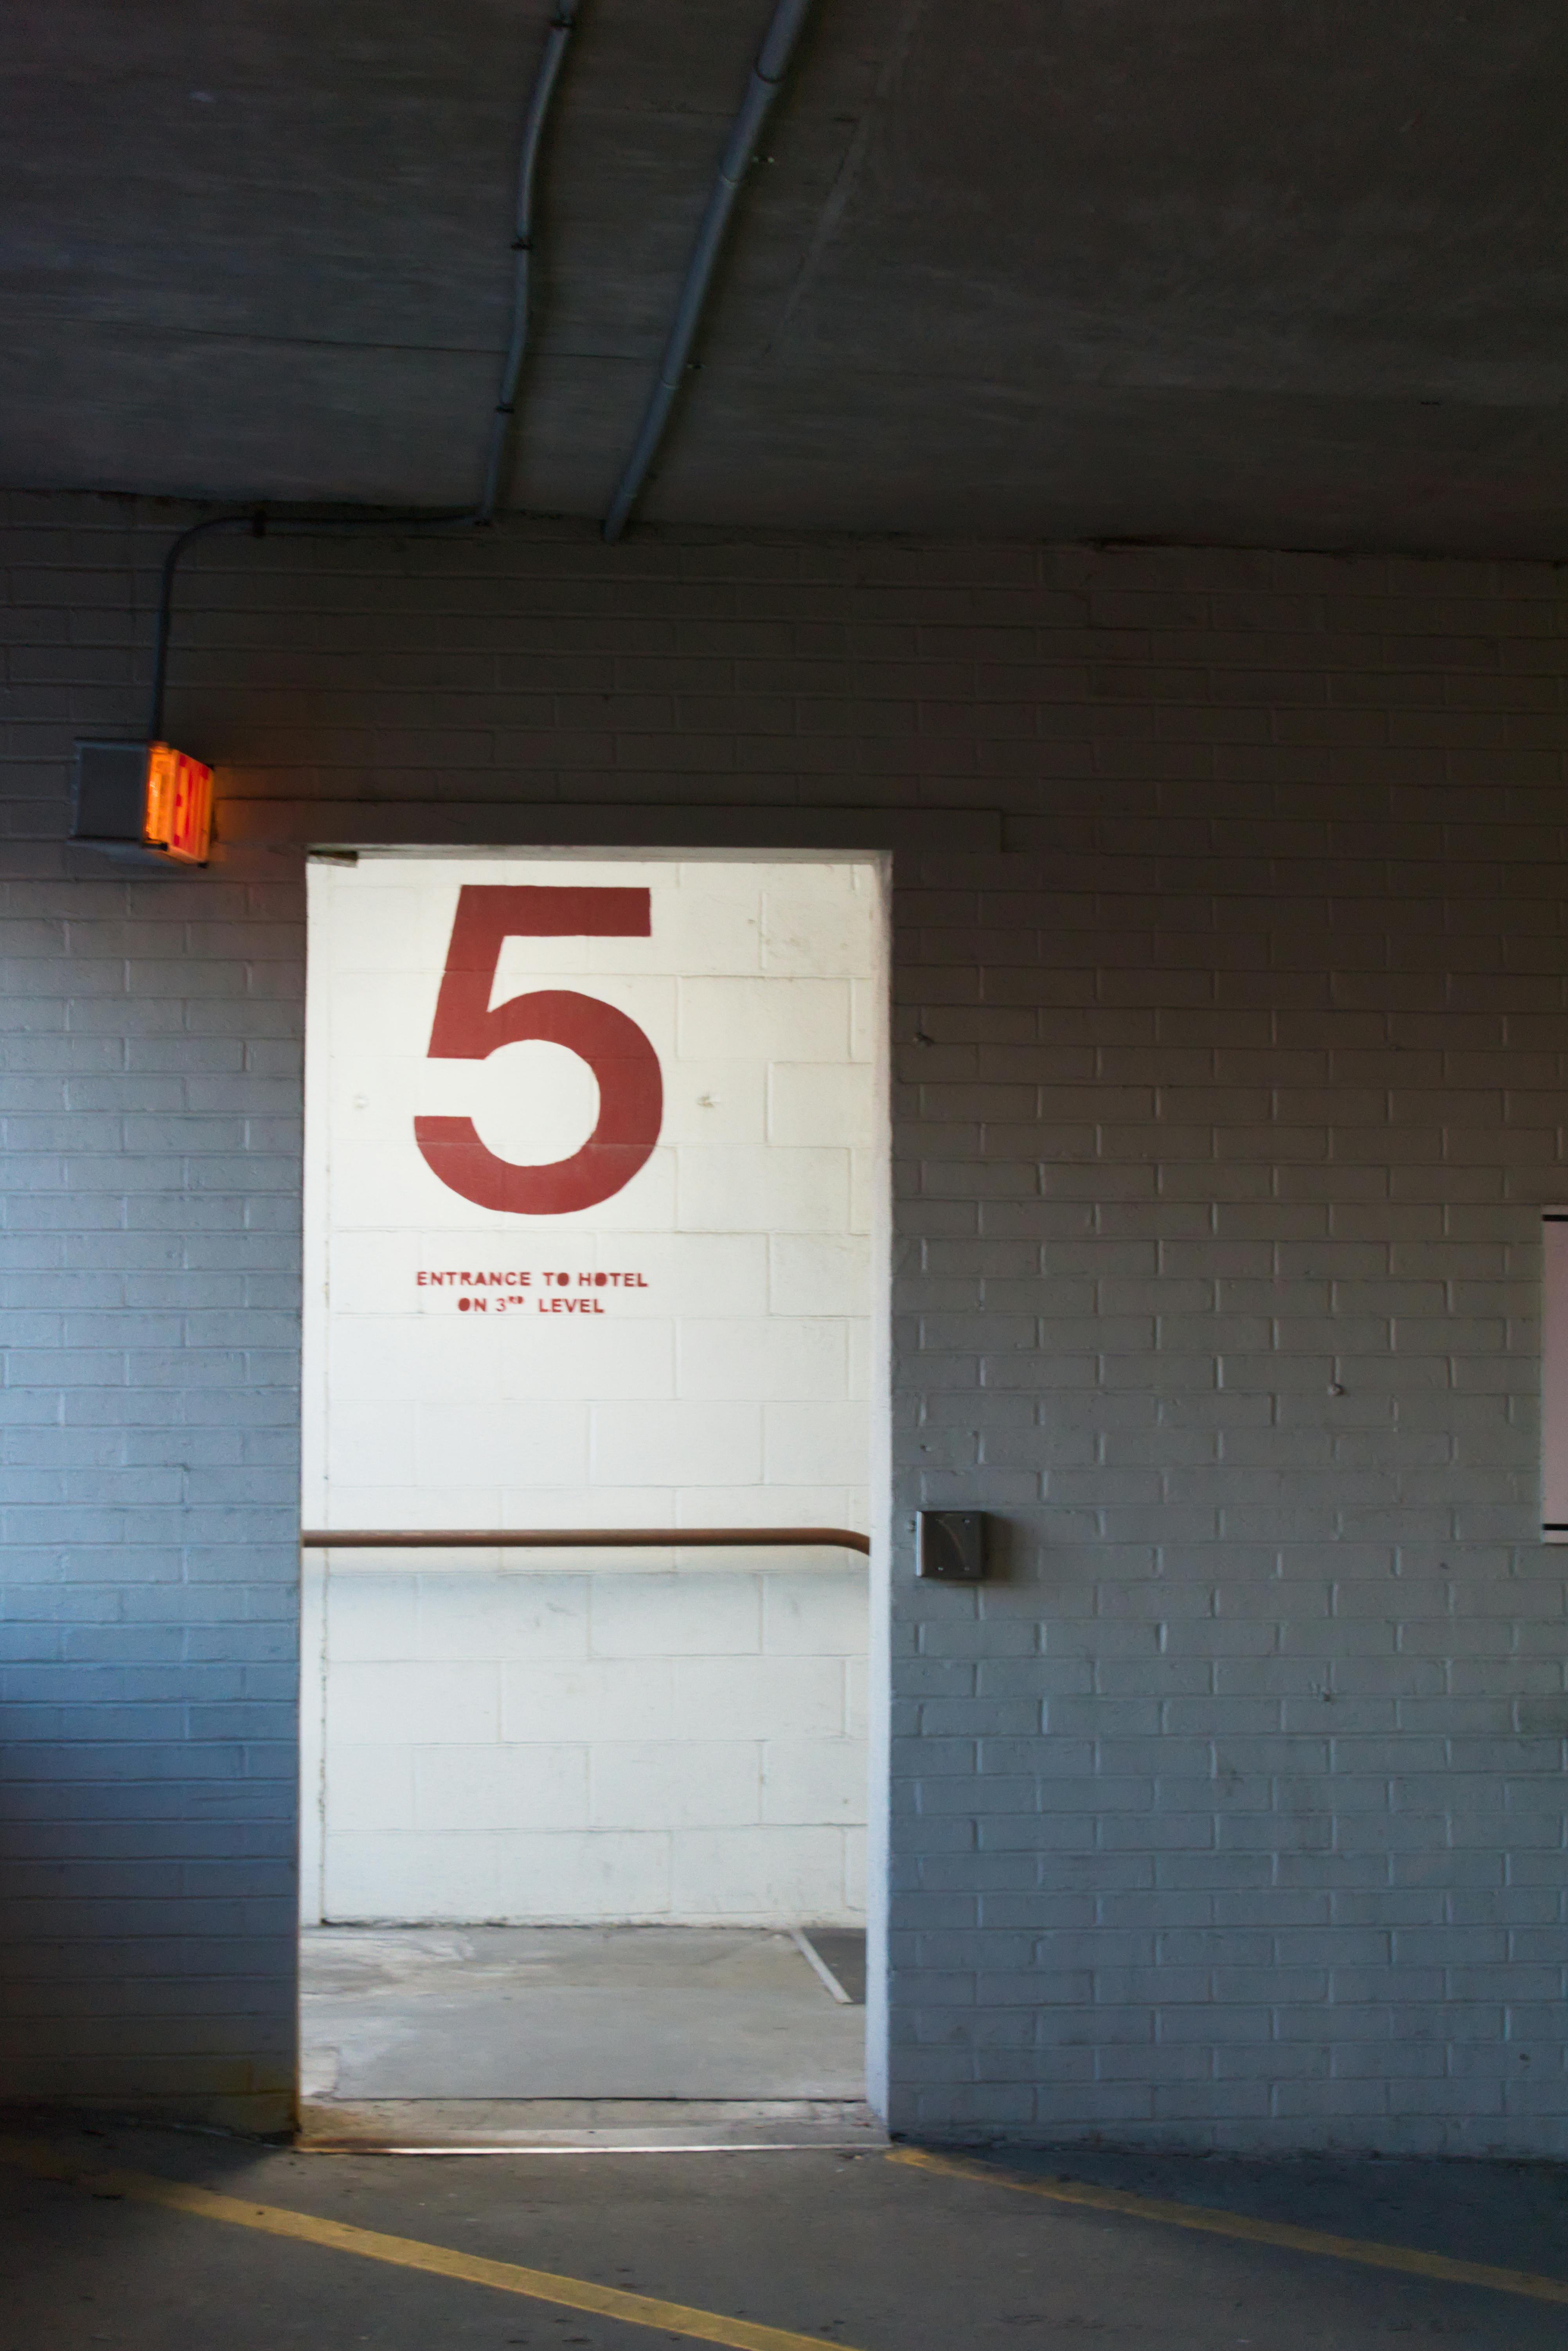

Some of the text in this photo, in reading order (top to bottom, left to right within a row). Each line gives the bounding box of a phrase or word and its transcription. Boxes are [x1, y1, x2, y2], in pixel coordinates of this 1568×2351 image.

[414, 884, 664, 1215] 5
[417, 1271, 649, 1288] ENTRANCE TO HOTEL
[458, 1296, 605, 1314] ON 3RD LEVEL
